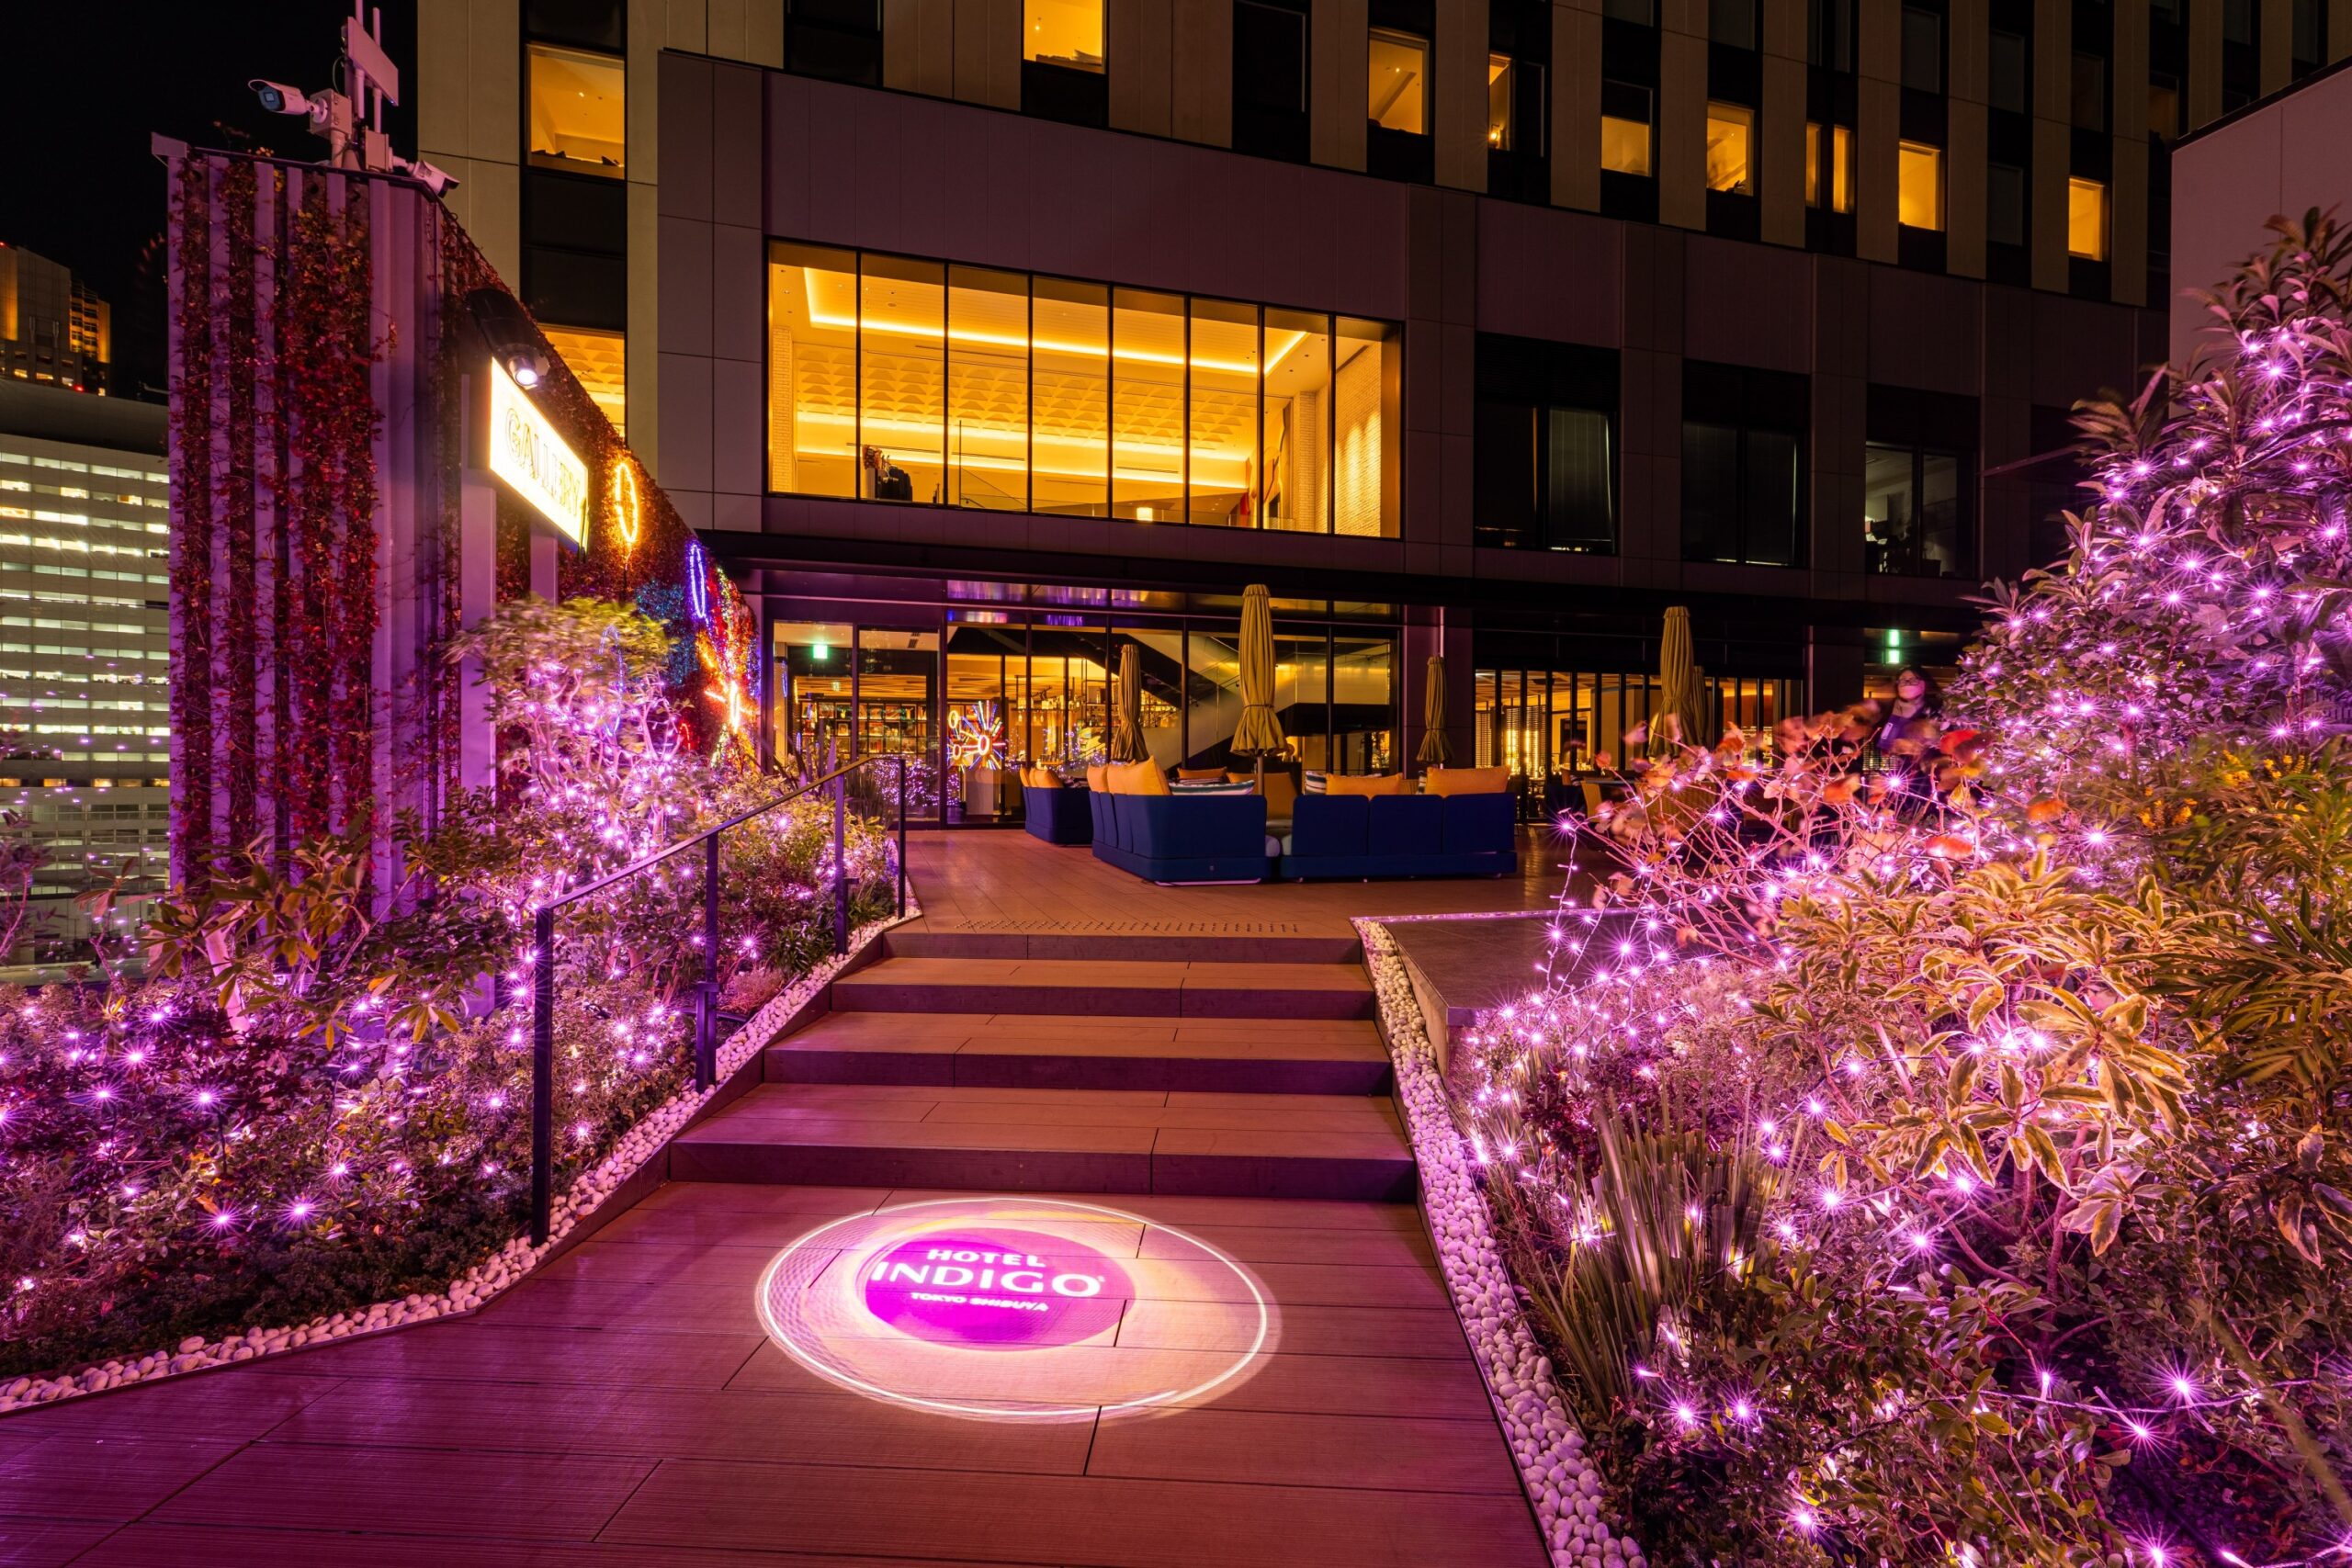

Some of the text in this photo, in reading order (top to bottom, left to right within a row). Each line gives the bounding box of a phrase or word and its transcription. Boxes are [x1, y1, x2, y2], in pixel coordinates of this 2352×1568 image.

[927, 1249, 1046, 1268] HOTEL
[871, 1261, 1102, 1297] INDIGO
[910, 1292, 1049, 1312] TOKYO SHIBUYA
